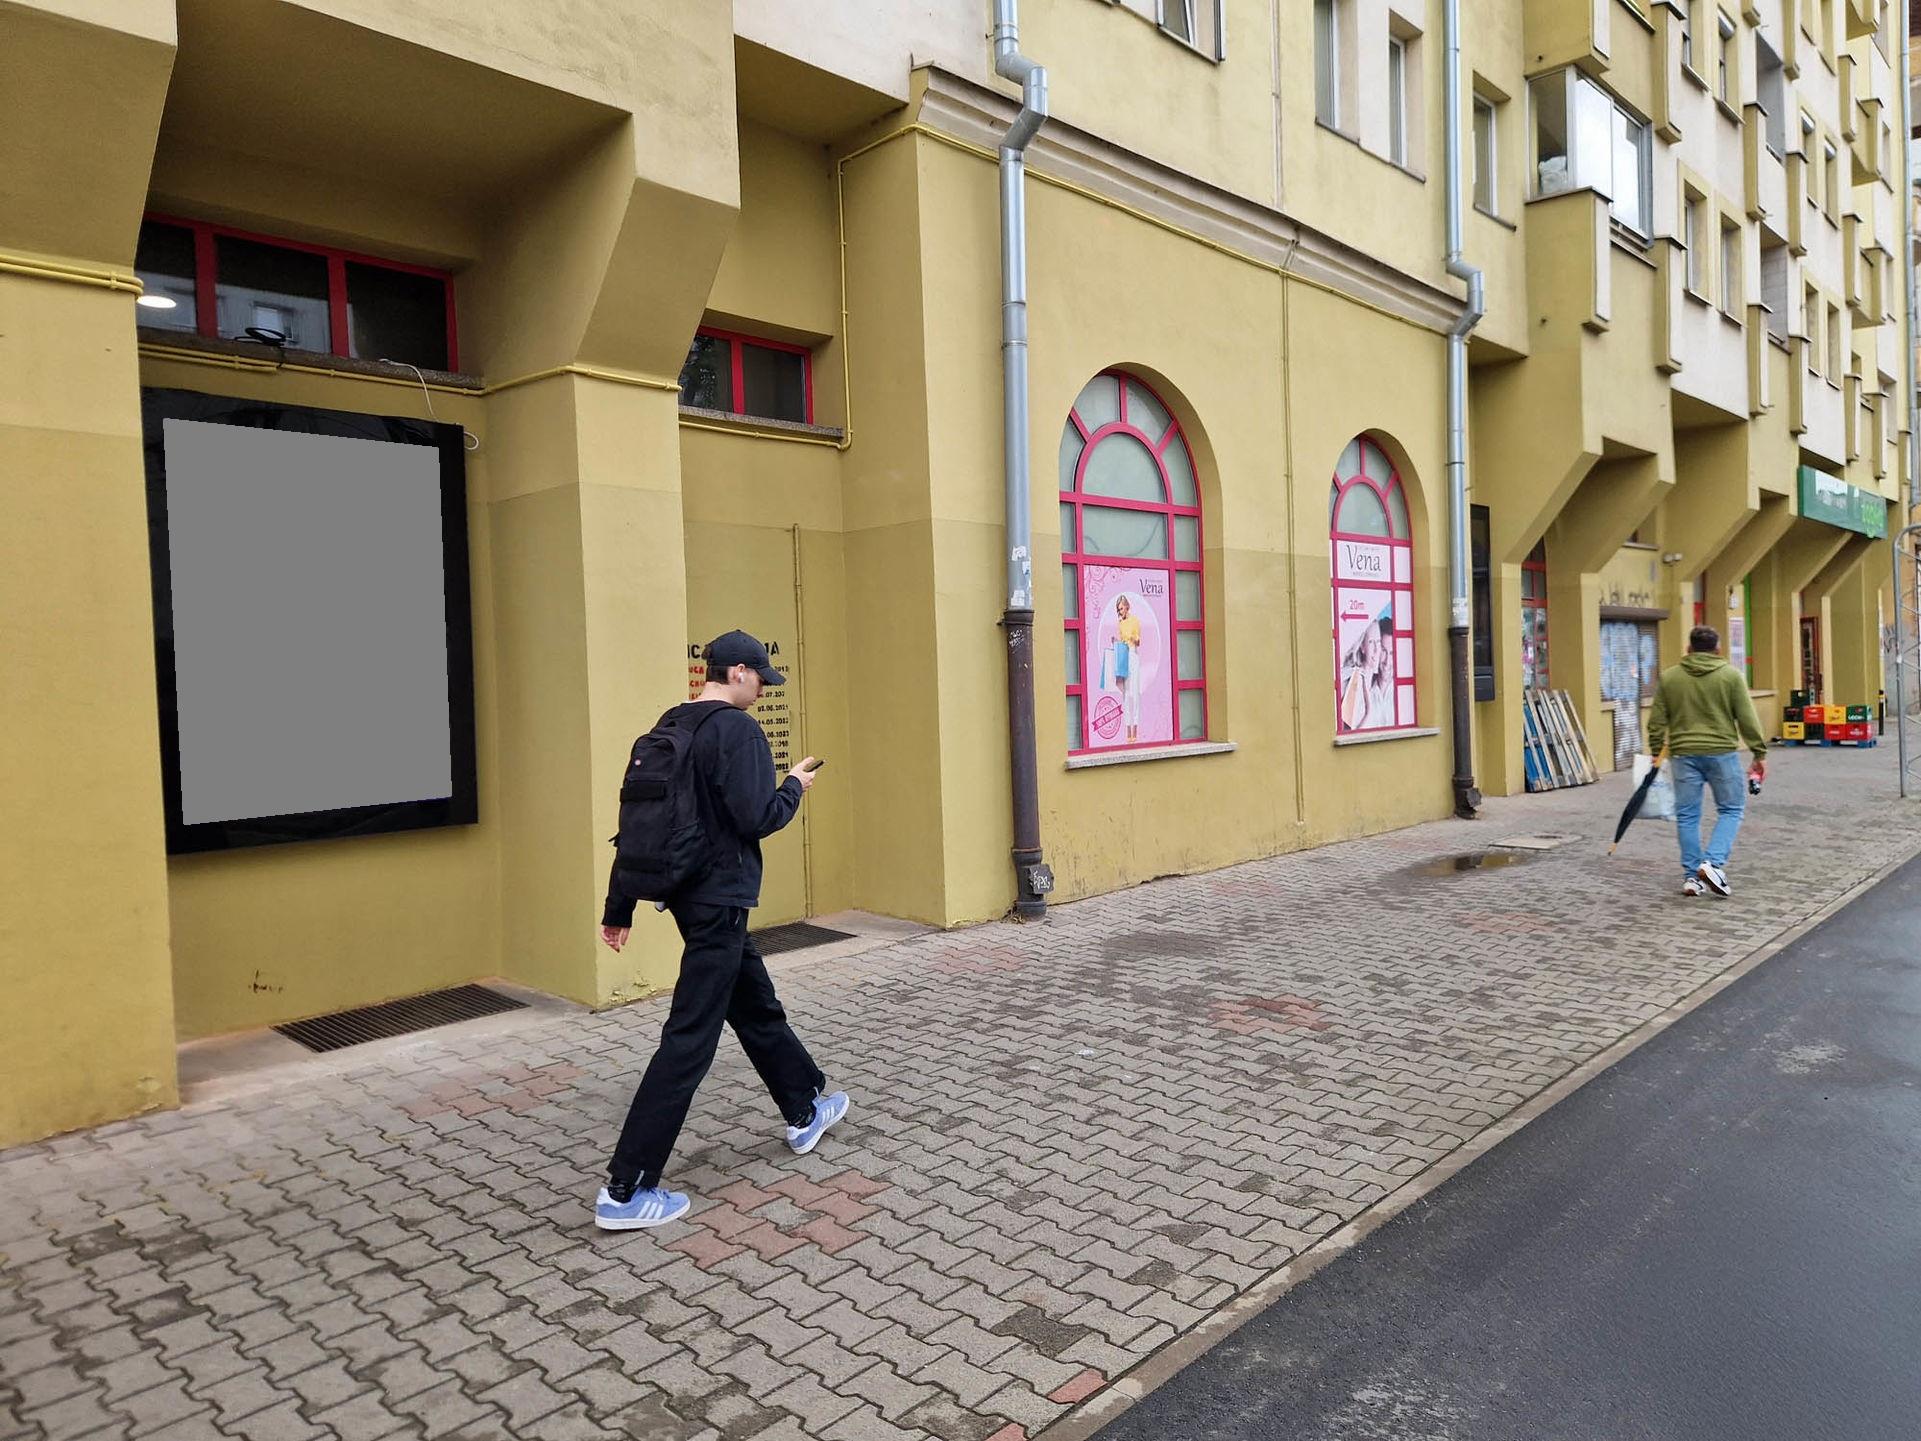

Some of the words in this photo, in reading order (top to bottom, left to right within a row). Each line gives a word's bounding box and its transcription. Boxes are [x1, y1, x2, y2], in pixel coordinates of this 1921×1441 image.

[1346, 545, 1381, 572] Vena
[1139, 579, 1163, 594] Vena
[1349, 600, 1365, 610] 20m
